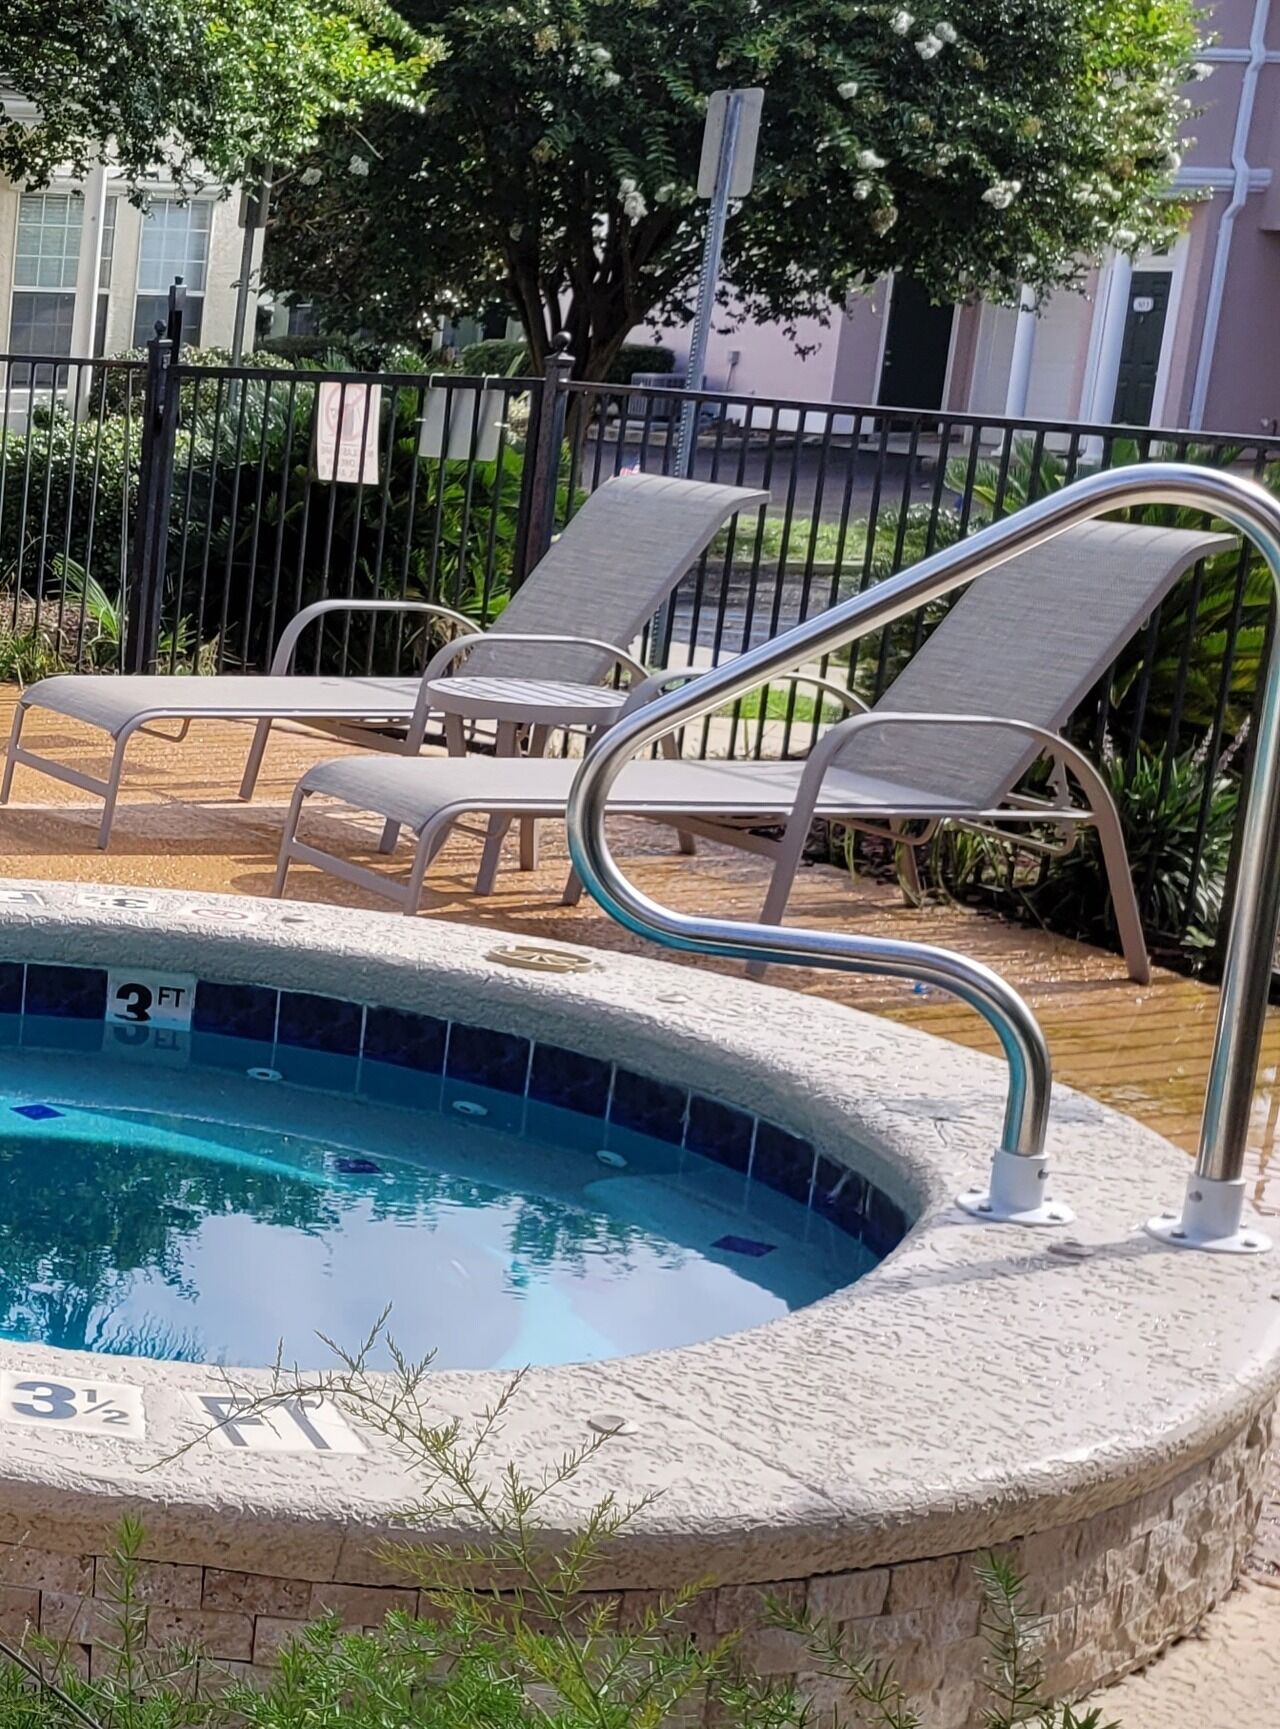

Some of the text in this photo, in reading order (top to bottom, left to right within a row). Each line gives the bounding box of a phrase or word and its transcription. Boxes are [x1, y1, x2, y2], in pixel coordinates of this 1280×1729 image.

[115, 983, 186, 1022] 3 FT
[198, 1395, 332, 1450] FT
